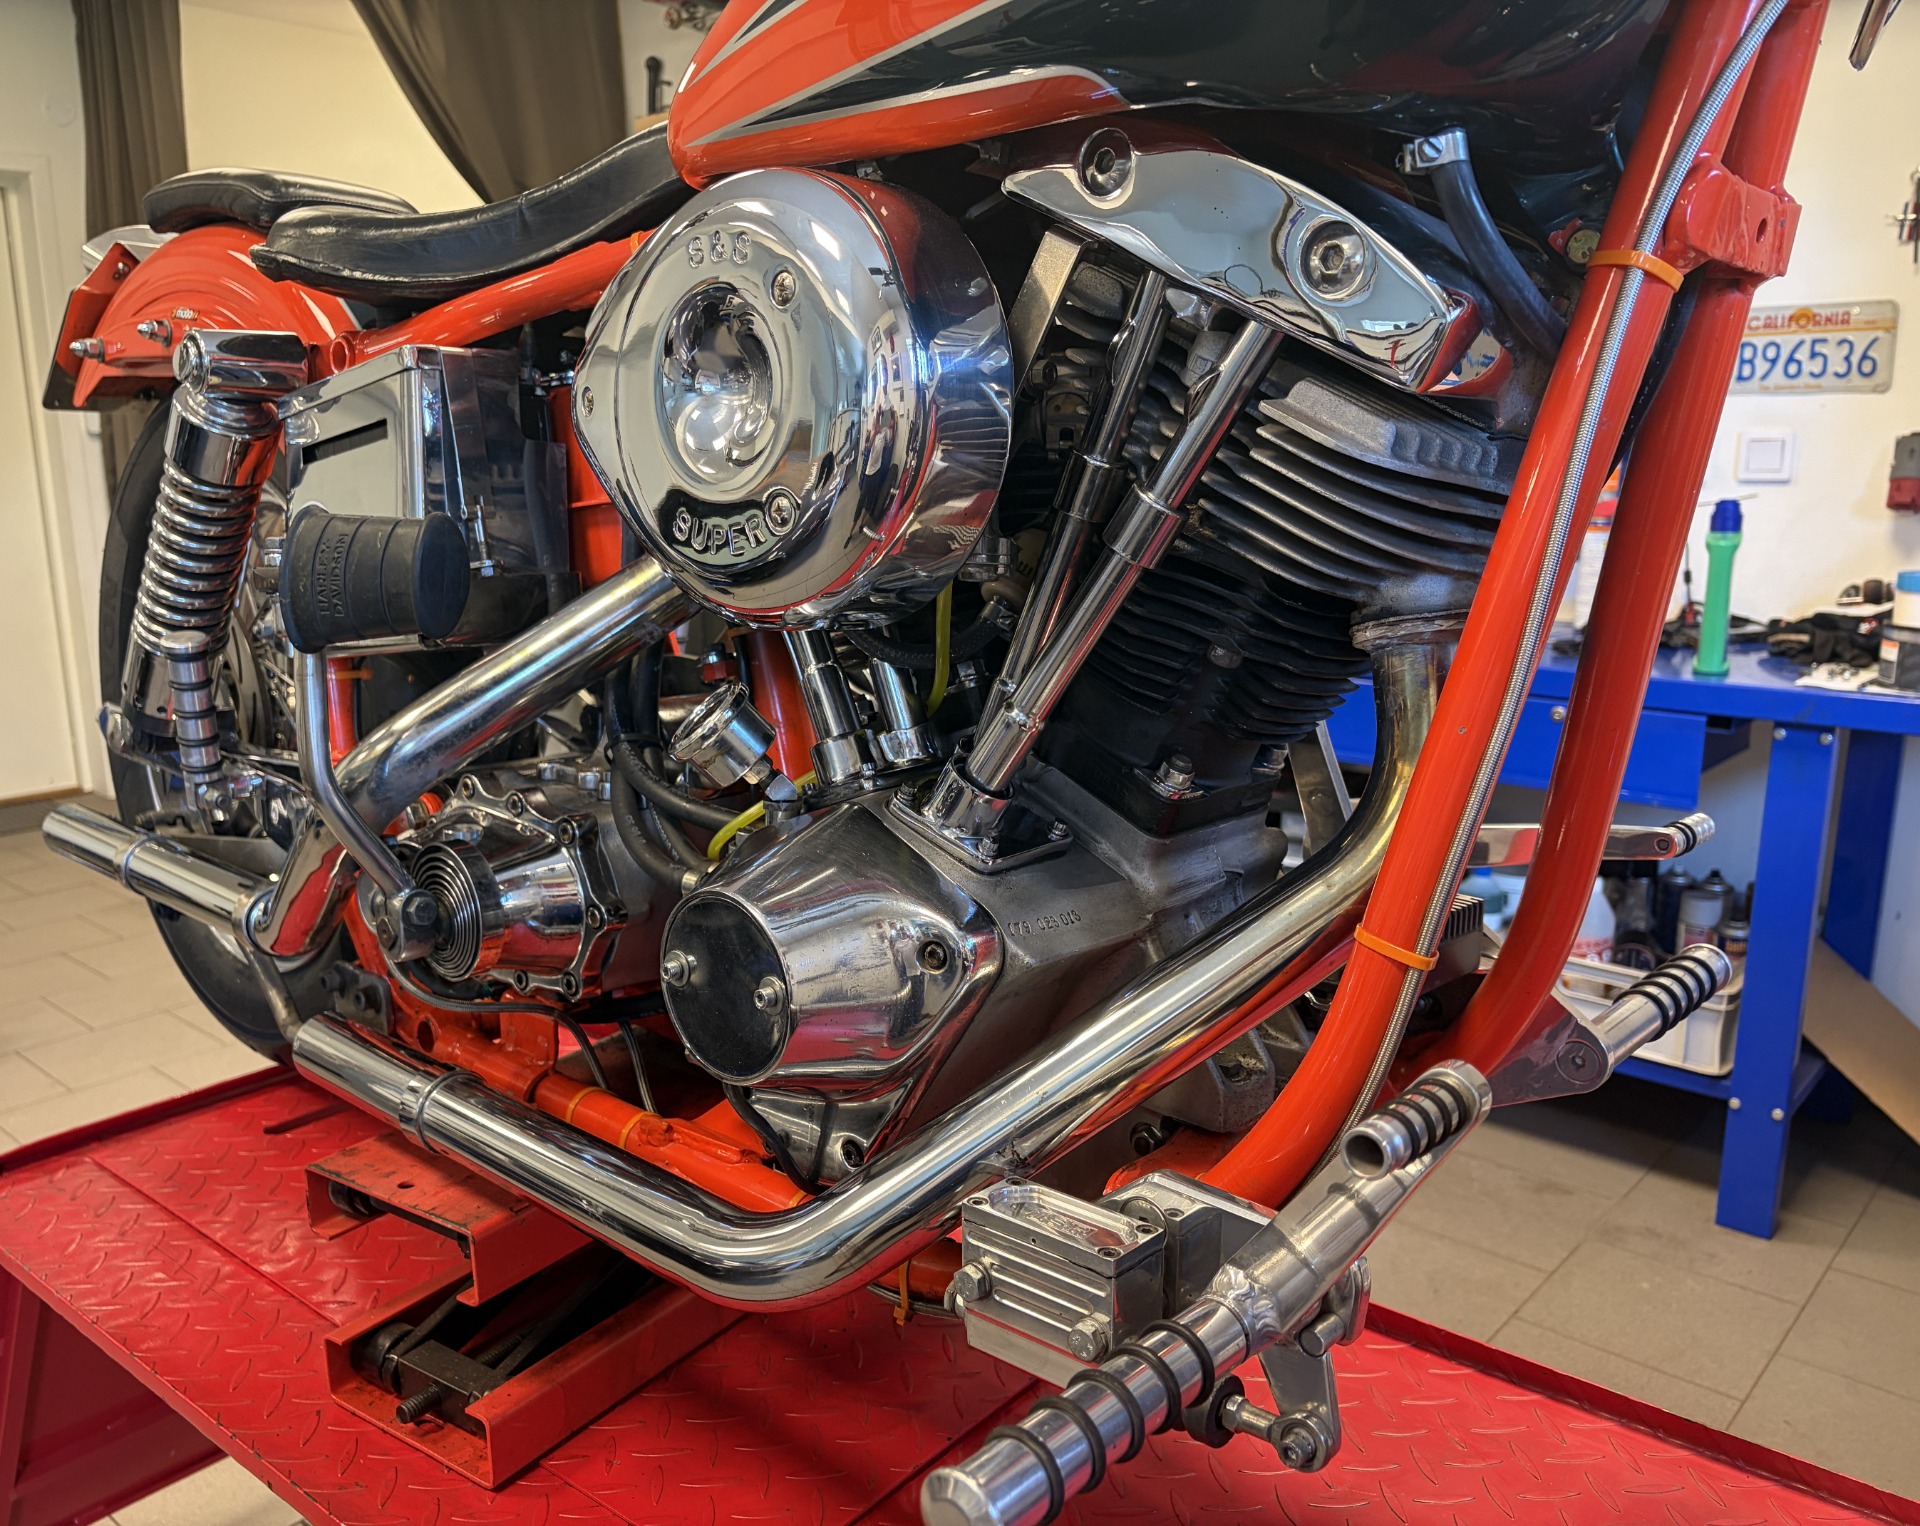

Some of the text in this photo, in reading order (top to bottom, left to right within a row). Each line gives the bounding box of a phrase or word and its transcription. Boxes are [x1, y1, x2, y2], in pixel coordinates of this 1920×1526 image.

[687, 229, 751, 269] S&S
[1747, 310, 1852, 332] CALIFORNIA
[1735, 337, 1881, 383] B96536
[672, 507, 768, 556] SUPER
[330, 533, 349, 617] DAVIDSON
